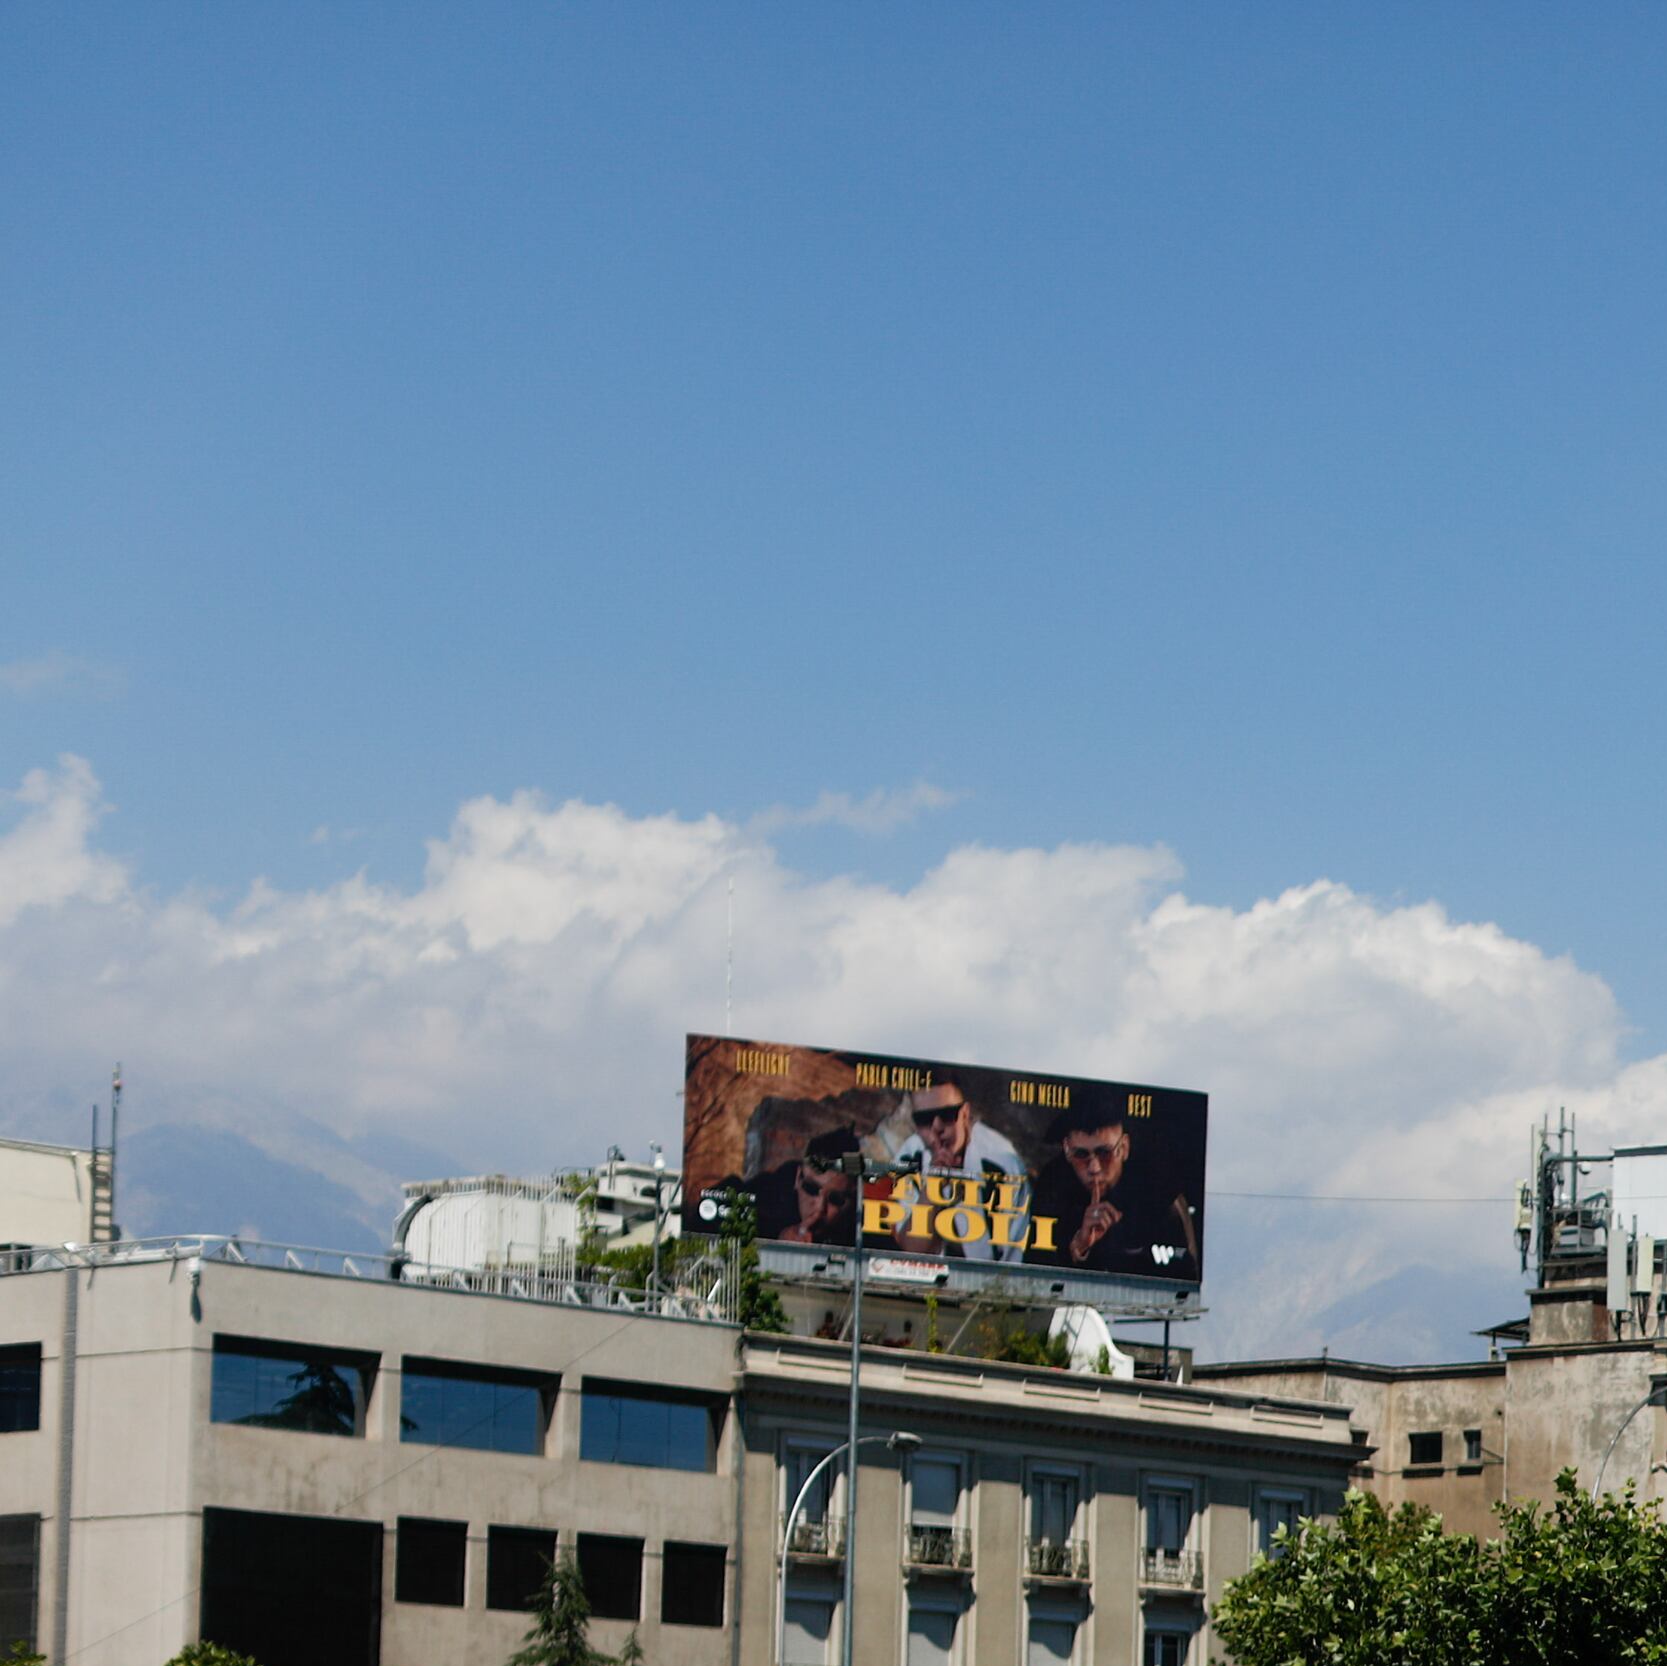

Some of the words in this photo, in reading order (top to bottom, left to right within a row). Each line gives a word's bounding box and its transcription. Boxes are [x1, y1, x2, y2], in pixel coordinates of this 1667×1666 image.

[856, 1063, 888, 1089] PABLO
[892, 1066, 933, 1093] CHILL-E
[1010, 1080, 1034, 1105] GINO
[1038, 1083, 1070, 1110] MELLA
[1128, 1093, 1152, 1119] BEST
[889, 1172, 1030, 1216] FULL
[862, 1199, 1058, 1252] PIOLI
